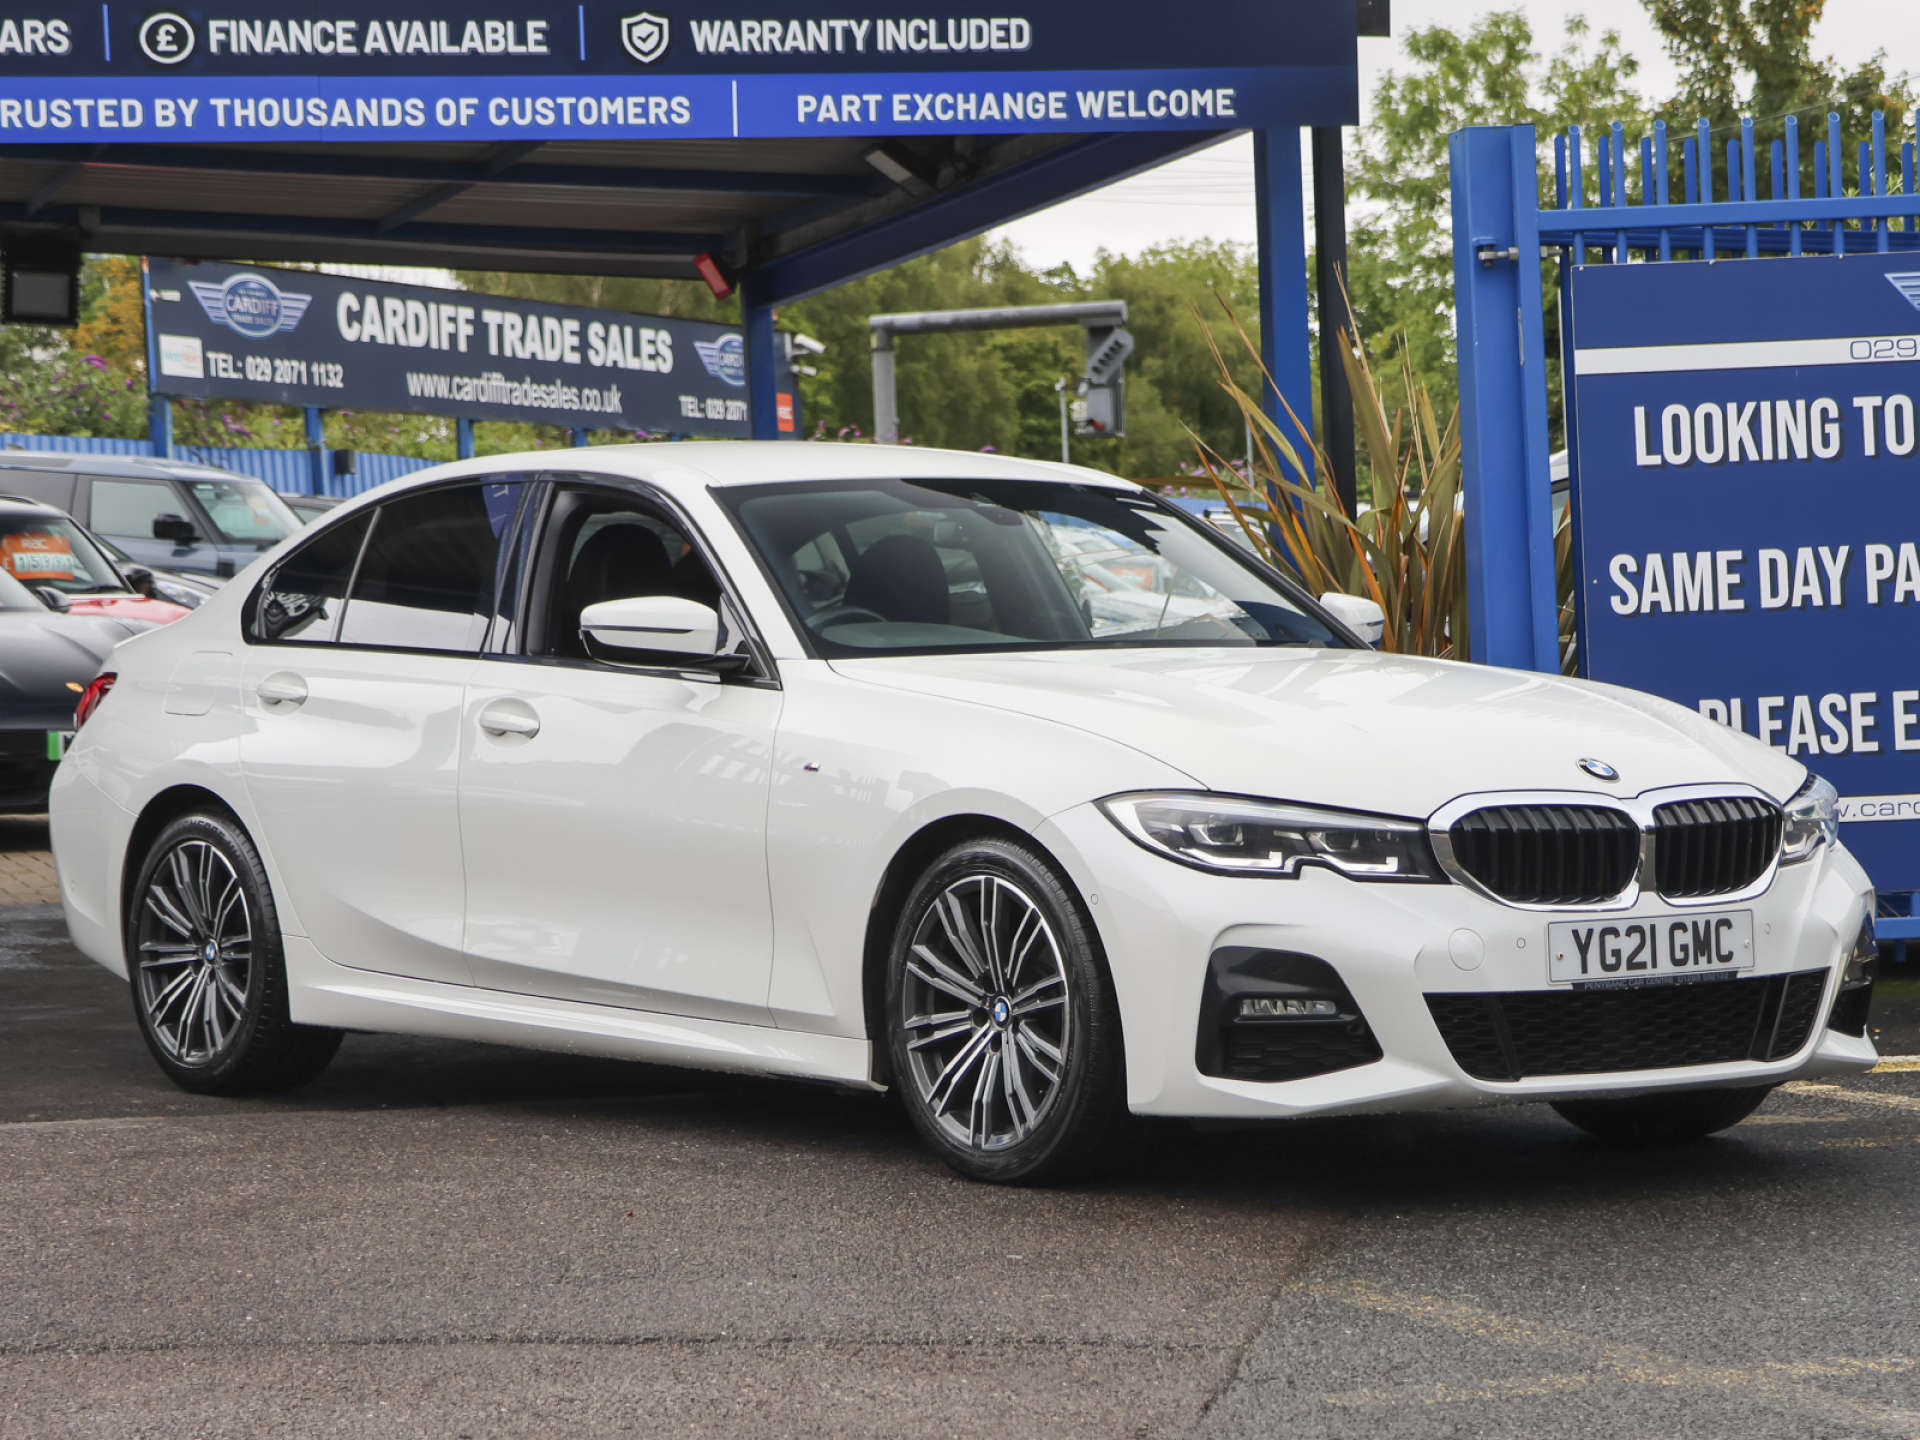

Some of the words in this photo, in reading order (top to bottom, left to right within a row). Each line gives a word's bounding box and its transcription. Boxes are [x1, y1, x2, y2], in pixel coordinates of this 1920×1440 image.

[0, 19, 70, 54] ARS
[208, 20, 358, 54] FINANCE
[364, 20, 548, 54] AVAILABLE
[690, 20, 870, 53] WARRANTY
[876, 18, 1031, 51] INCLUDED
[0, 98, 143, 129] RUSTED
[154, 98, 199, 128] BY
[209, 97, 426, 127] THOUSANDS
[435, 97, 479, 127] OF
[494, 95, 691, 126] CUSTOMERS
[797, 94, 882, 123] PART
[892, 91, 1067, 122] EXCHANGE
[1075, 88, 1235, 119] WELCOME
[226, 294, 279, 317] CARDIFF
[336, 291, 475, 353] CARDIFF
[481, 309, 582, 364] TRADE
[587, 321, 674, 374] SALES
[1849, 337, 1918, 361] 029
[206, 351, 243, 380] TEL:
[245, 355, 273, 383] 029
[273, 358, 308, 385] 2071
[311, 361, 344, 389] 1132
[406, 372, 623, 414] www.cardifftradesales.co.uk
[1633, 397, 1841, 467] LOOKING
[1852, 393, 1916, 458] TO
[1608, 549, 1746, 616] SAME
[1758, 545, 1850, 609] DAY
[1865, 542, 1920, 604] PA
[1571, 923, 1658, 975] YG21
[1668, 917, 1734, 968] GMC
